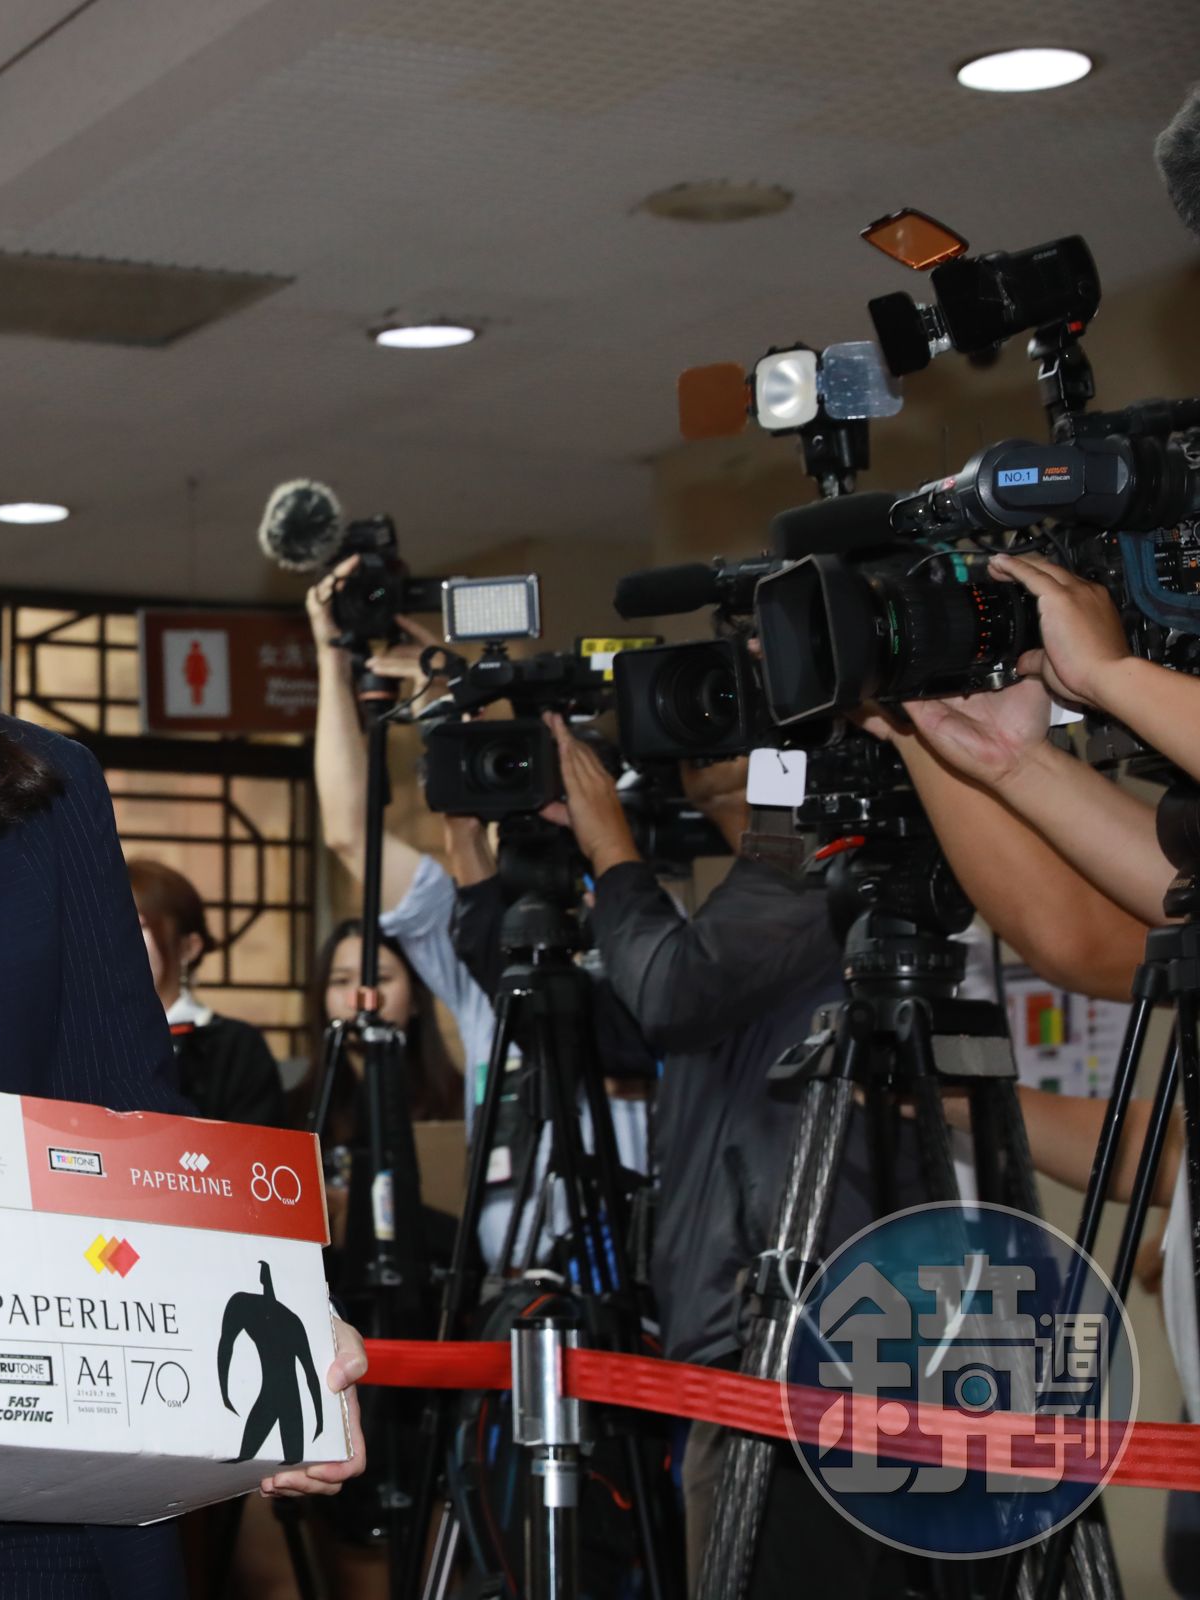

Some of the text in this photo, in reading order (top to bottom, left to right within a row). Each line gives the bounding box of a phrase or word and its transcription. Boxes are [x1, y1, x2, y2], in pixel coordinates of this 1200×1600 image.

[1004, 471, 1030, 483] NO.1
[55, 1154, 96, 1167] TRUTONE
[129, 1162, 301, 1203] PAPERLINE 80
[77, 1356, 113, 1387] A4
[130, 1360, 190, 1405] 70
[8, 1395, 40, 1408] FAST
[167, 1399, 182, 1408] GSM
